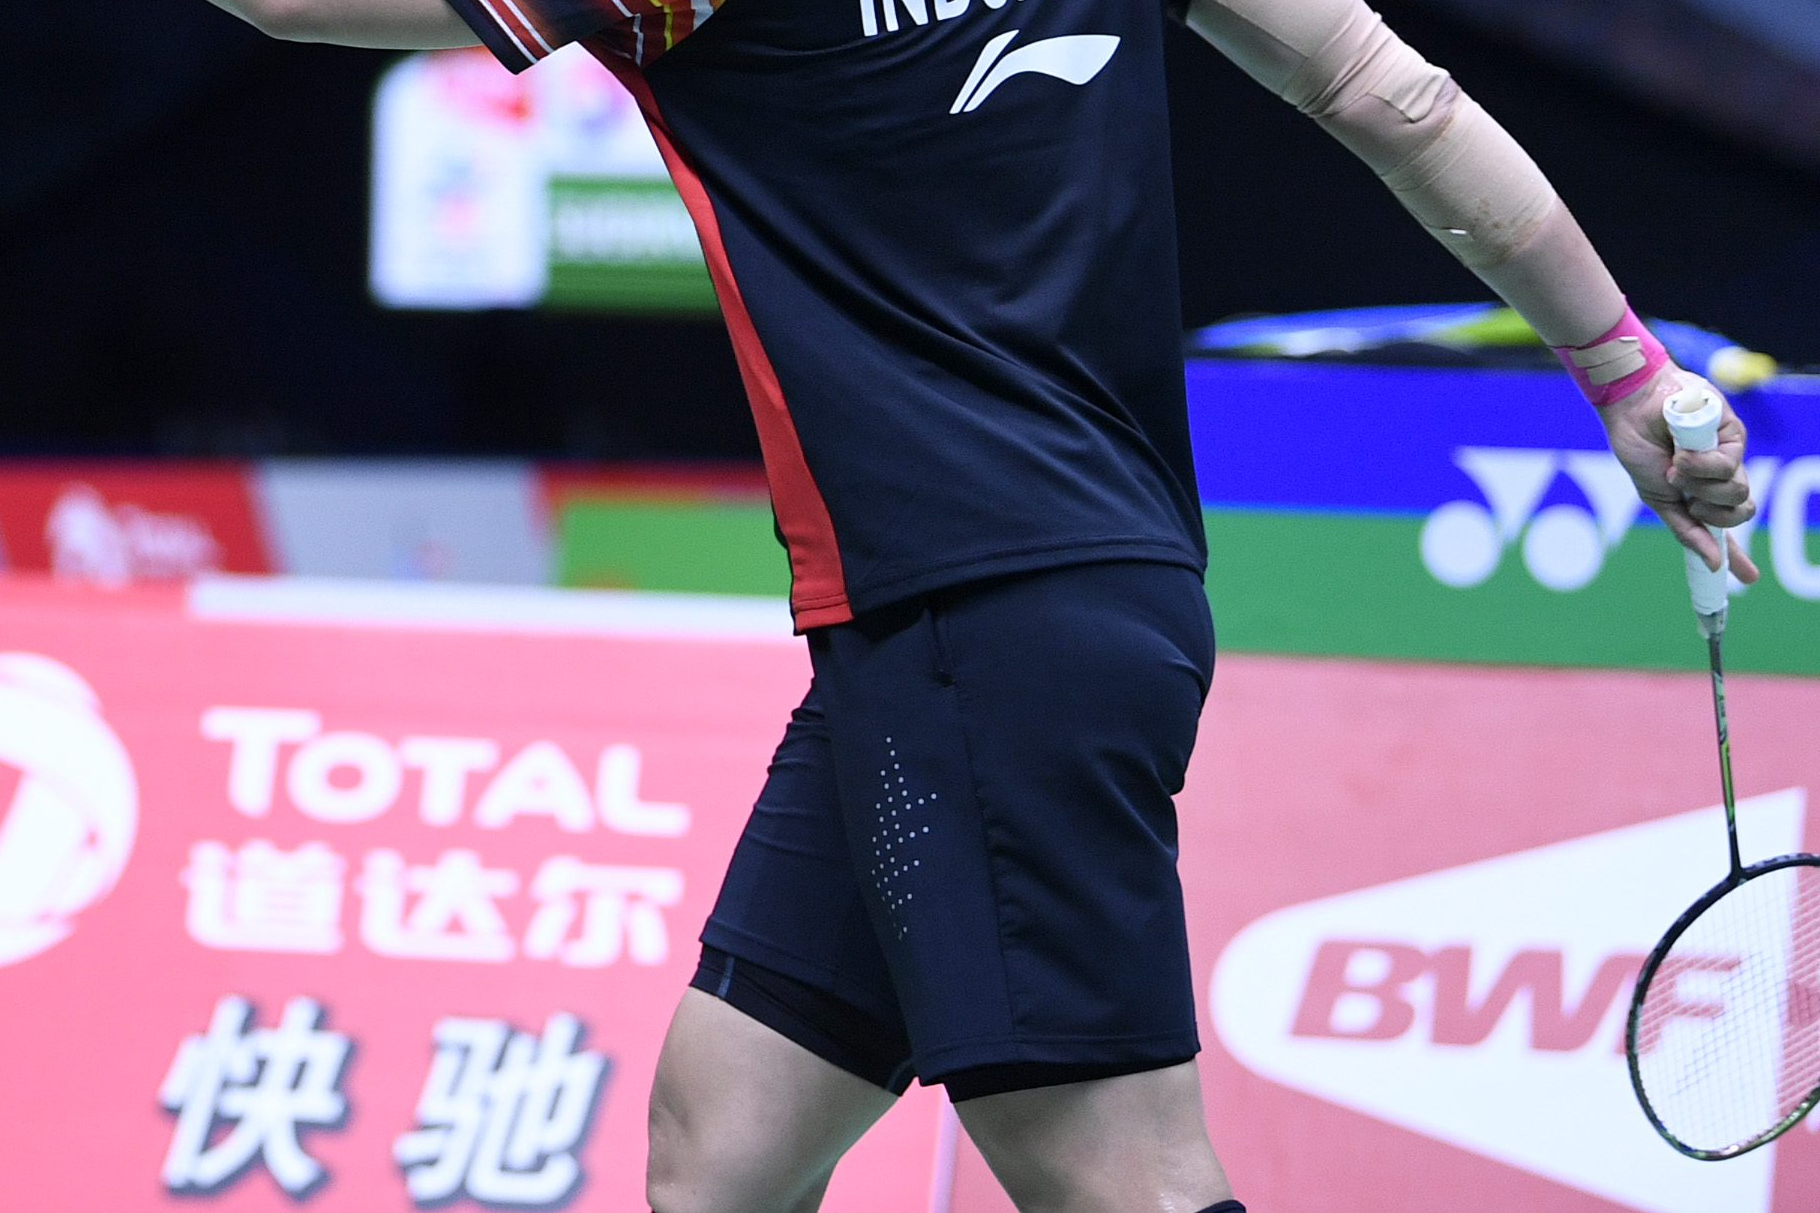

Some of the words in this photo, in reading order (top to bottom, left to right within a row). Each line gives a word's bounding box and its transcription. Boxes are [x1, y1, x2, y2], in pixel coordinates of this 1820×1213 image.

[201, 707, 690, 835] TOTAL
[183, 840, 684, 967] 道达尔
[1288, 939, 1743, 1055] BWF
[160, 995, 604, 1205] 快驰
